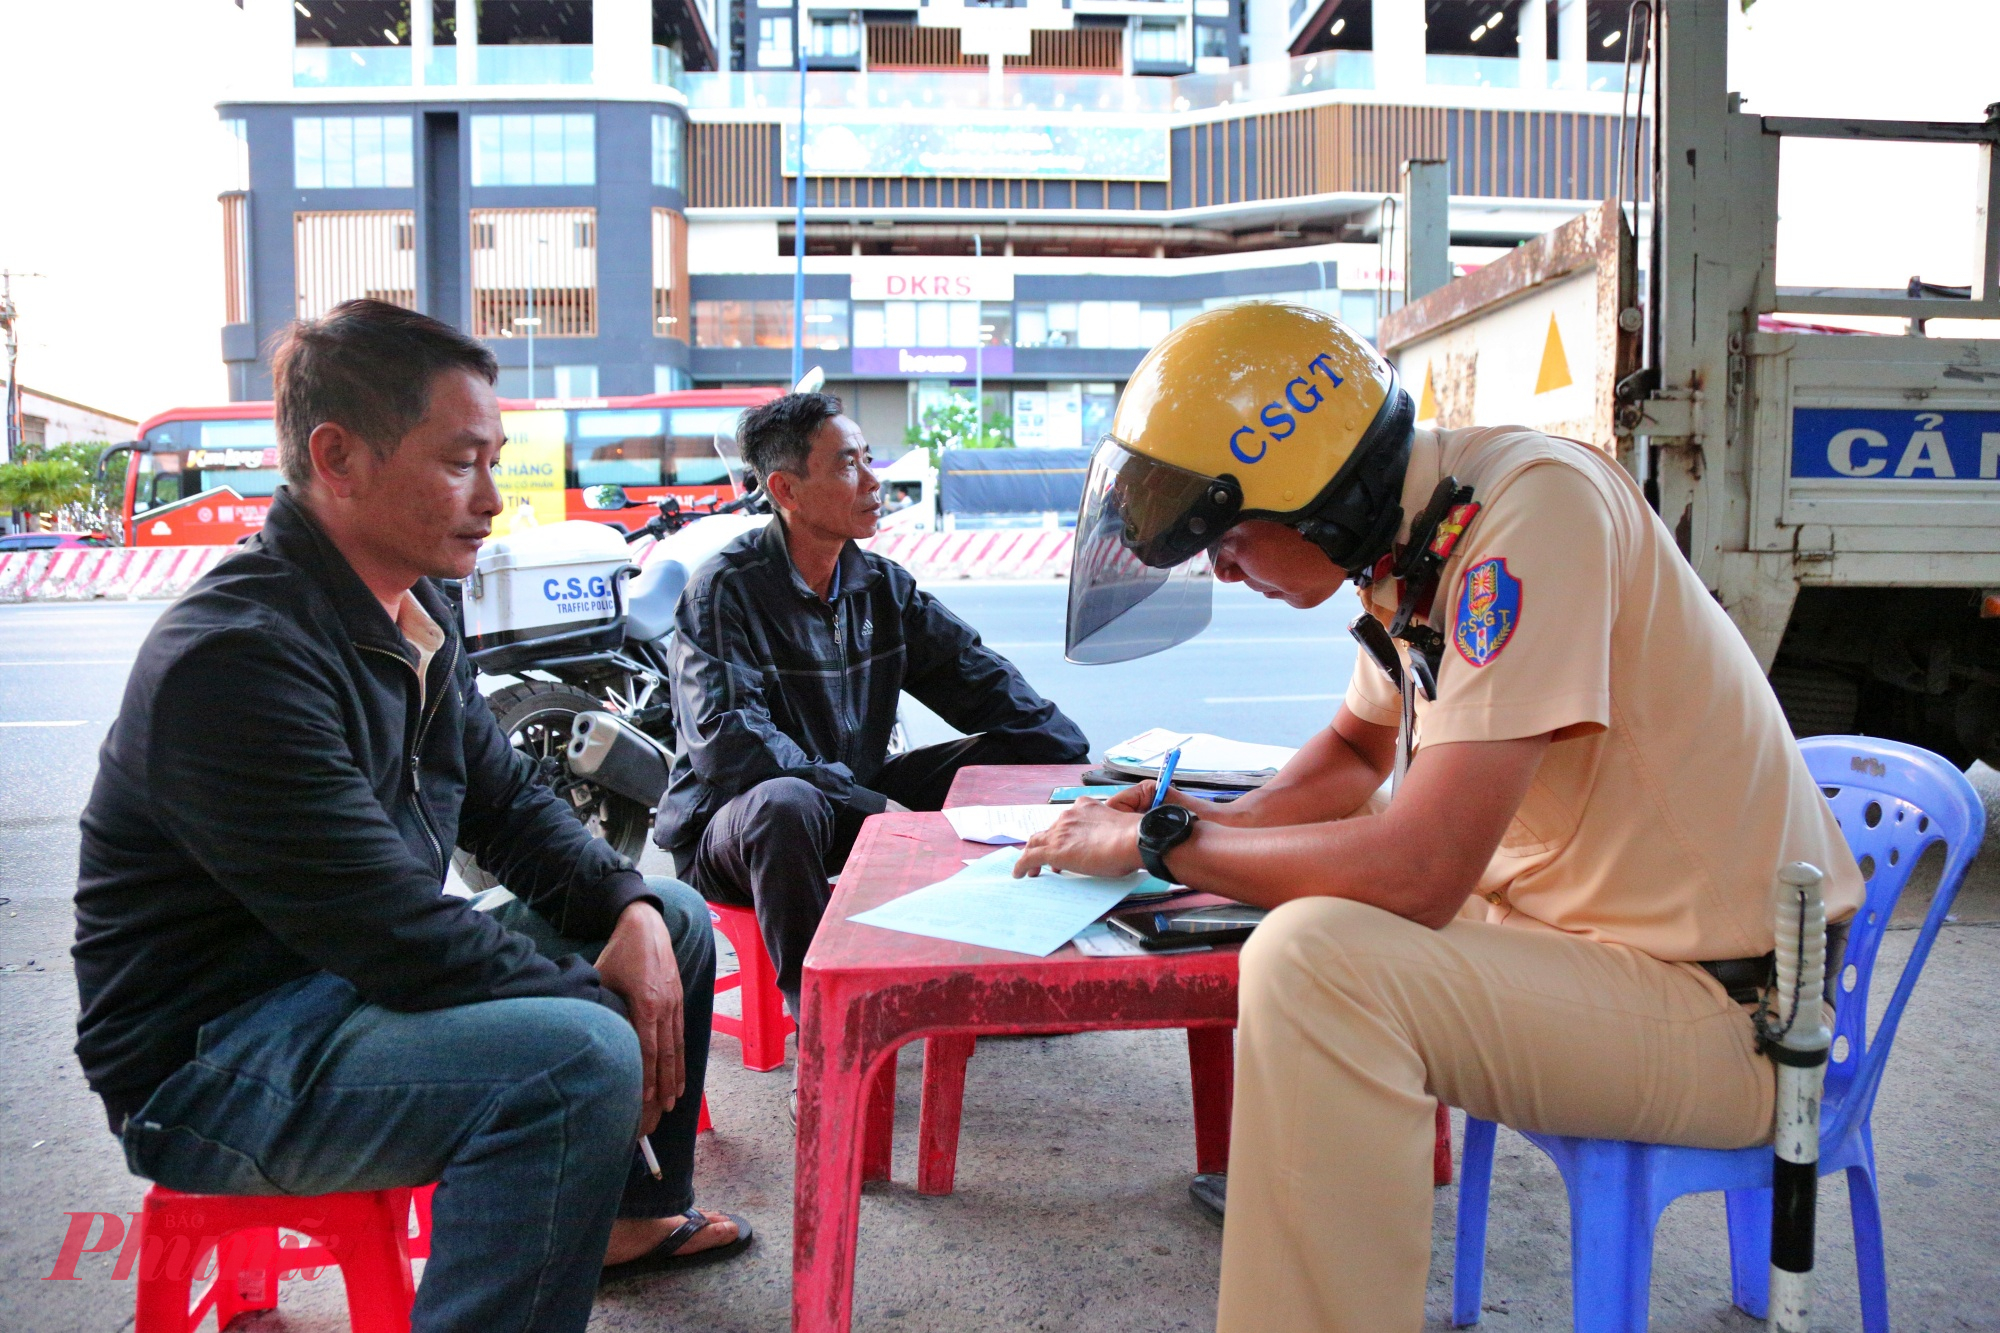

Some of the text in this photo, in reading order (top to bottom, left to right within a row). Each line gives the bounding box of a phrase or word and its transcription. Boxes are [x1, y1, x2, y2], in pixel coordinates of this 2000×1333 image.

[887, 275, 971, 296] DKRS
[1229, 352, 1345, 464] CSGT
[1827, 413, 1956, 477] CẢ
[557, 601, 590, 614] TRAFFIC
[1459, 609, 1510, 637] CSGT
